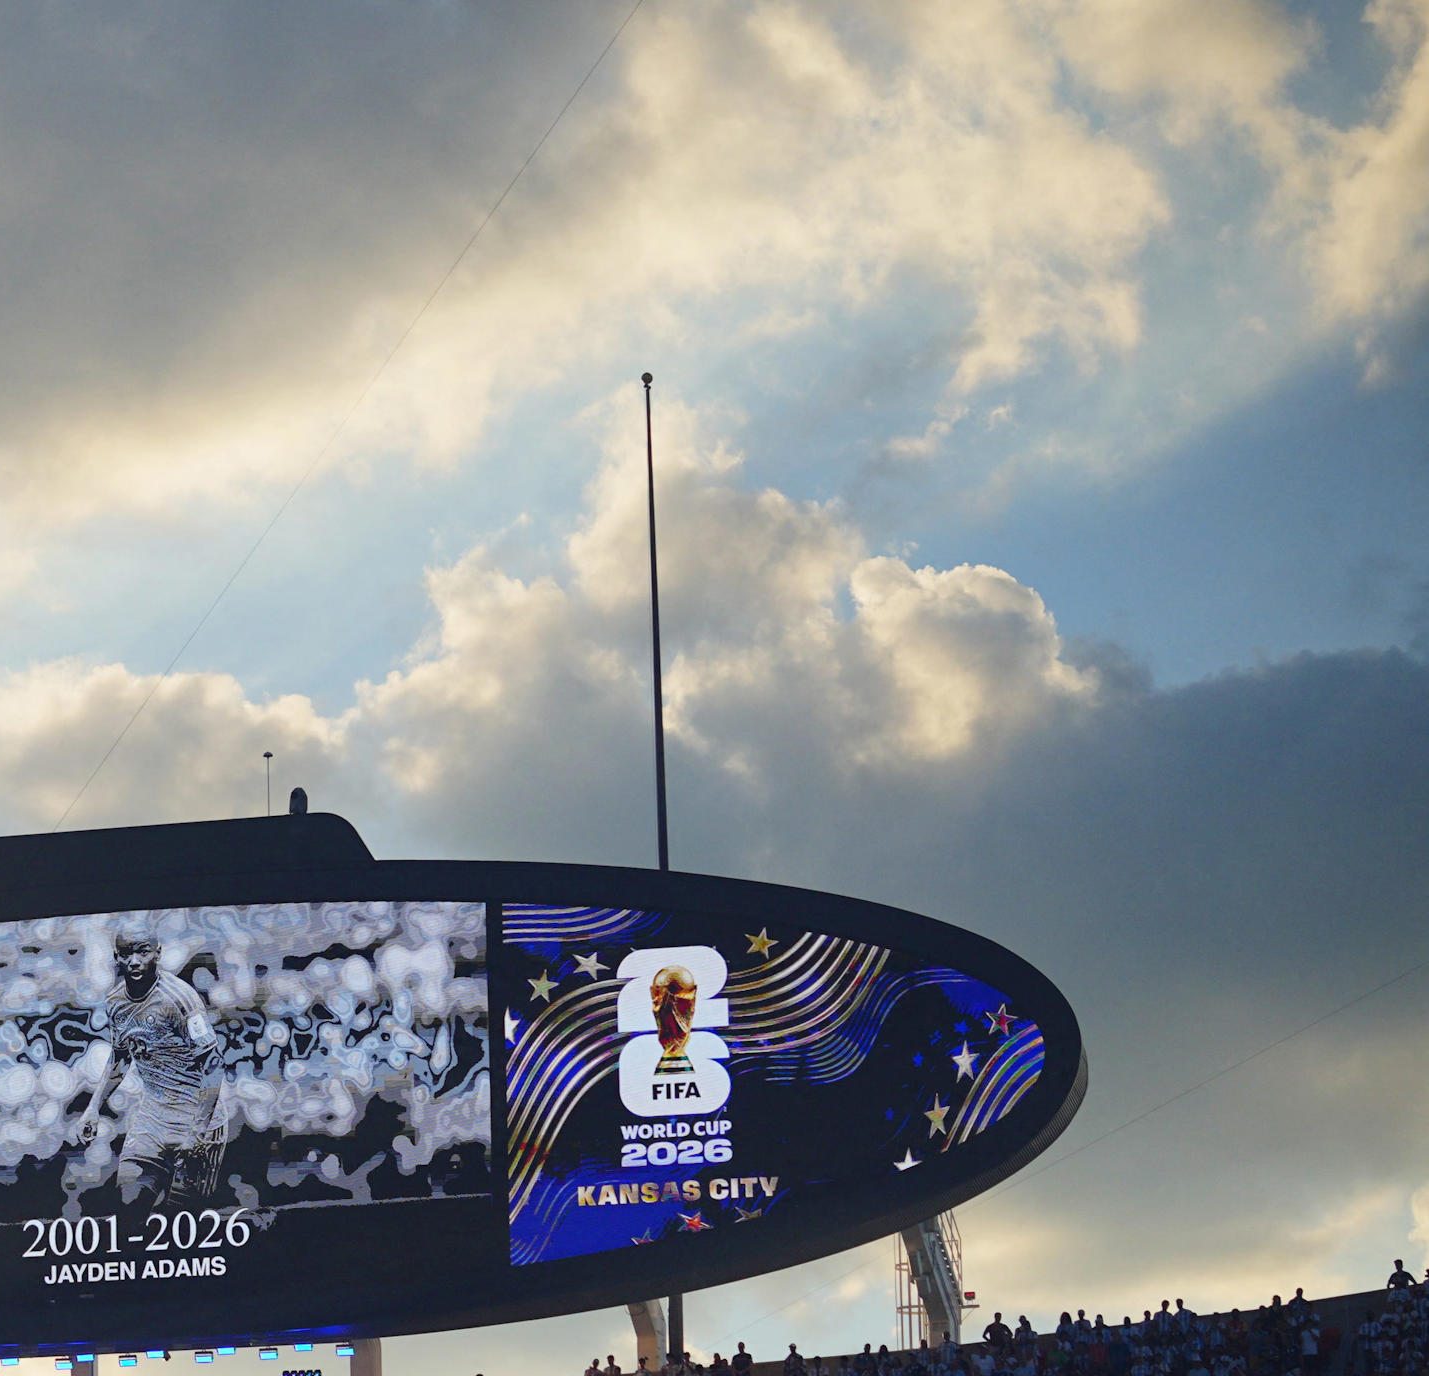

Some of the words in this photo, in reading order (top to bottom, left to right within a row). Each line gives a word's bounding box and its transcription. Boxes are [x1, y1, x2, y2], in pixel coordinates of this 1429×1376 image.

[652, 1081, 701, 1100] FIFA
[620, 1121, 691, 1140] WORLD
[693, 1119, 733, 1137] CUP
[620, 1138, 733, 1168] 2026
[577, 1179, 702, 1207] KANSAS
[709, 1176, 779, 1201] CITY
[44, 1261, 135, 1284] JAYDEN
[142, 1256, 226, 1280] ADAMS
